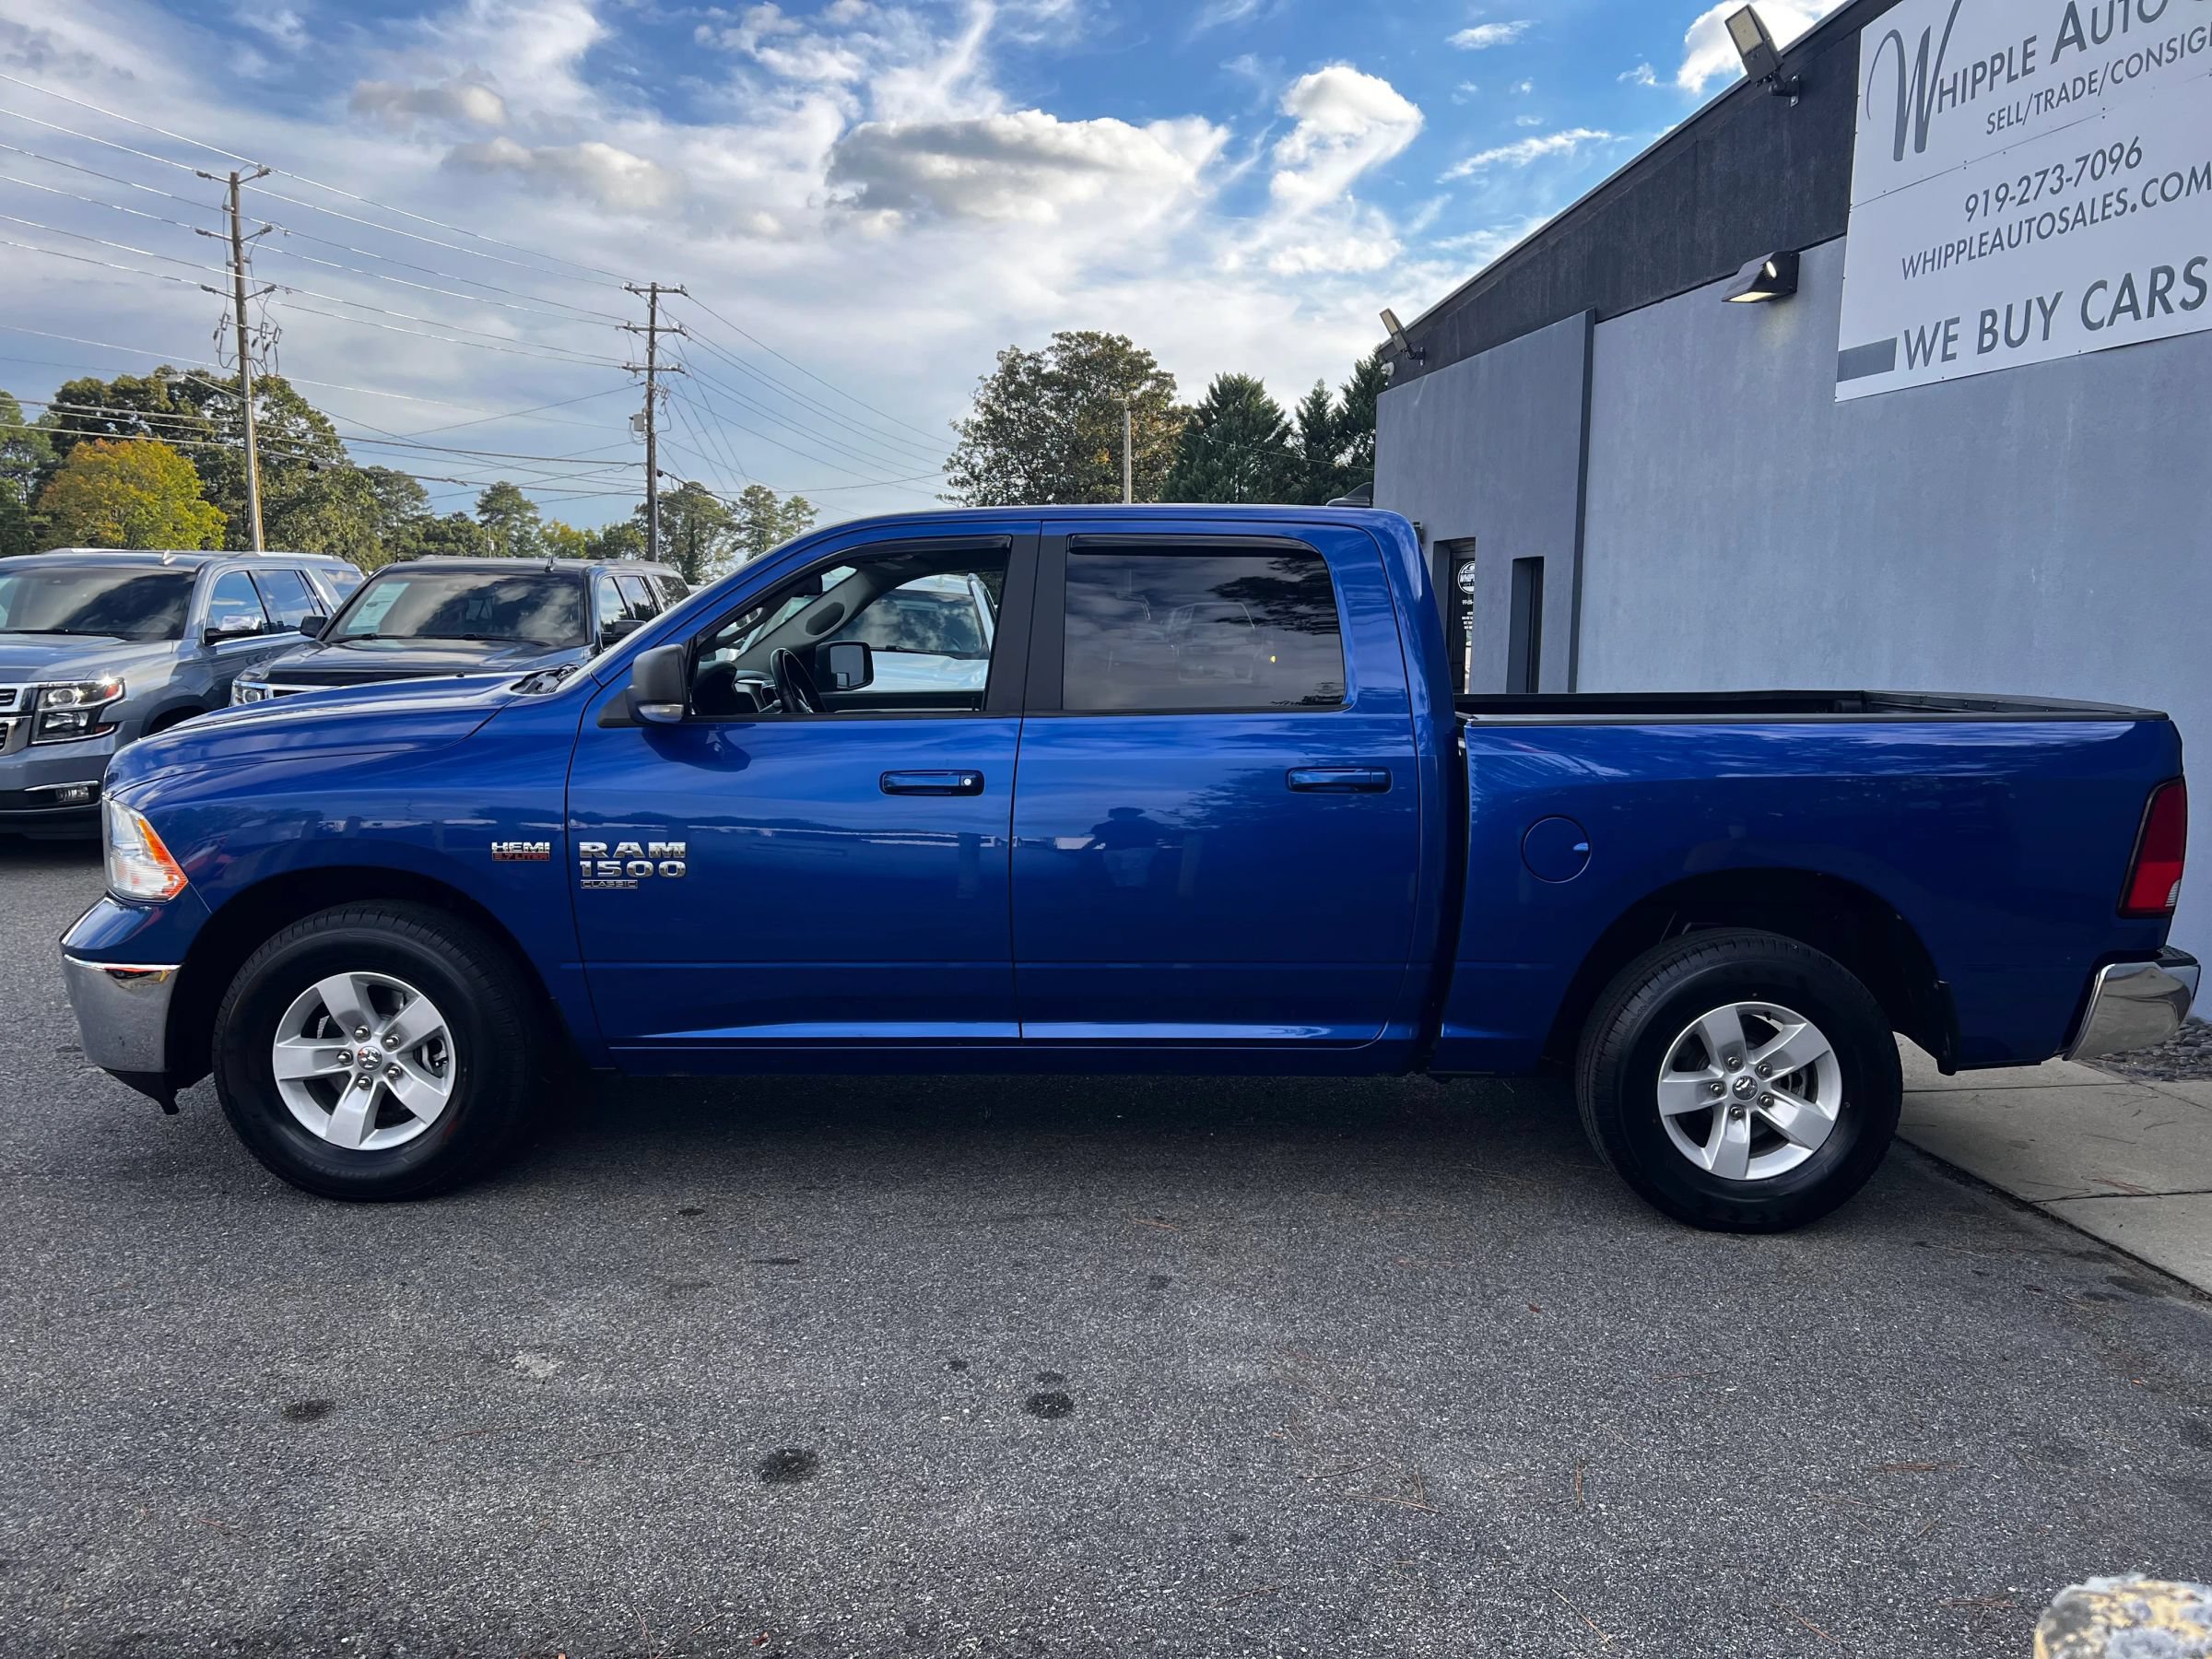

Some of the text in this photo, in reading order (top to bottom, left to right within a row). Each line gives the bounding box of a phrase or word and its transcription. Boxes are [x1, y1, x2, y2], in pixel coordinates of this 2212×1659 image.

[1866, 0, 2037, 161] WHIPPLE
[1986, 21, 2212, 135] SELL/TRADE/CONSIG
[1901, 161, 2212, 280] WHIPPLEAUTOSALES.COM
[1965, 136, 2142, 222] 919-273-7096
[1904, 255, 2208, 371] WE BUY CARS
[491, 841, 550, 852] HEMI
[579, 841, 687, 859] RAM
[579, 861, 687, 877] 1500
[582, 880, 637, 888] CLASSIC
